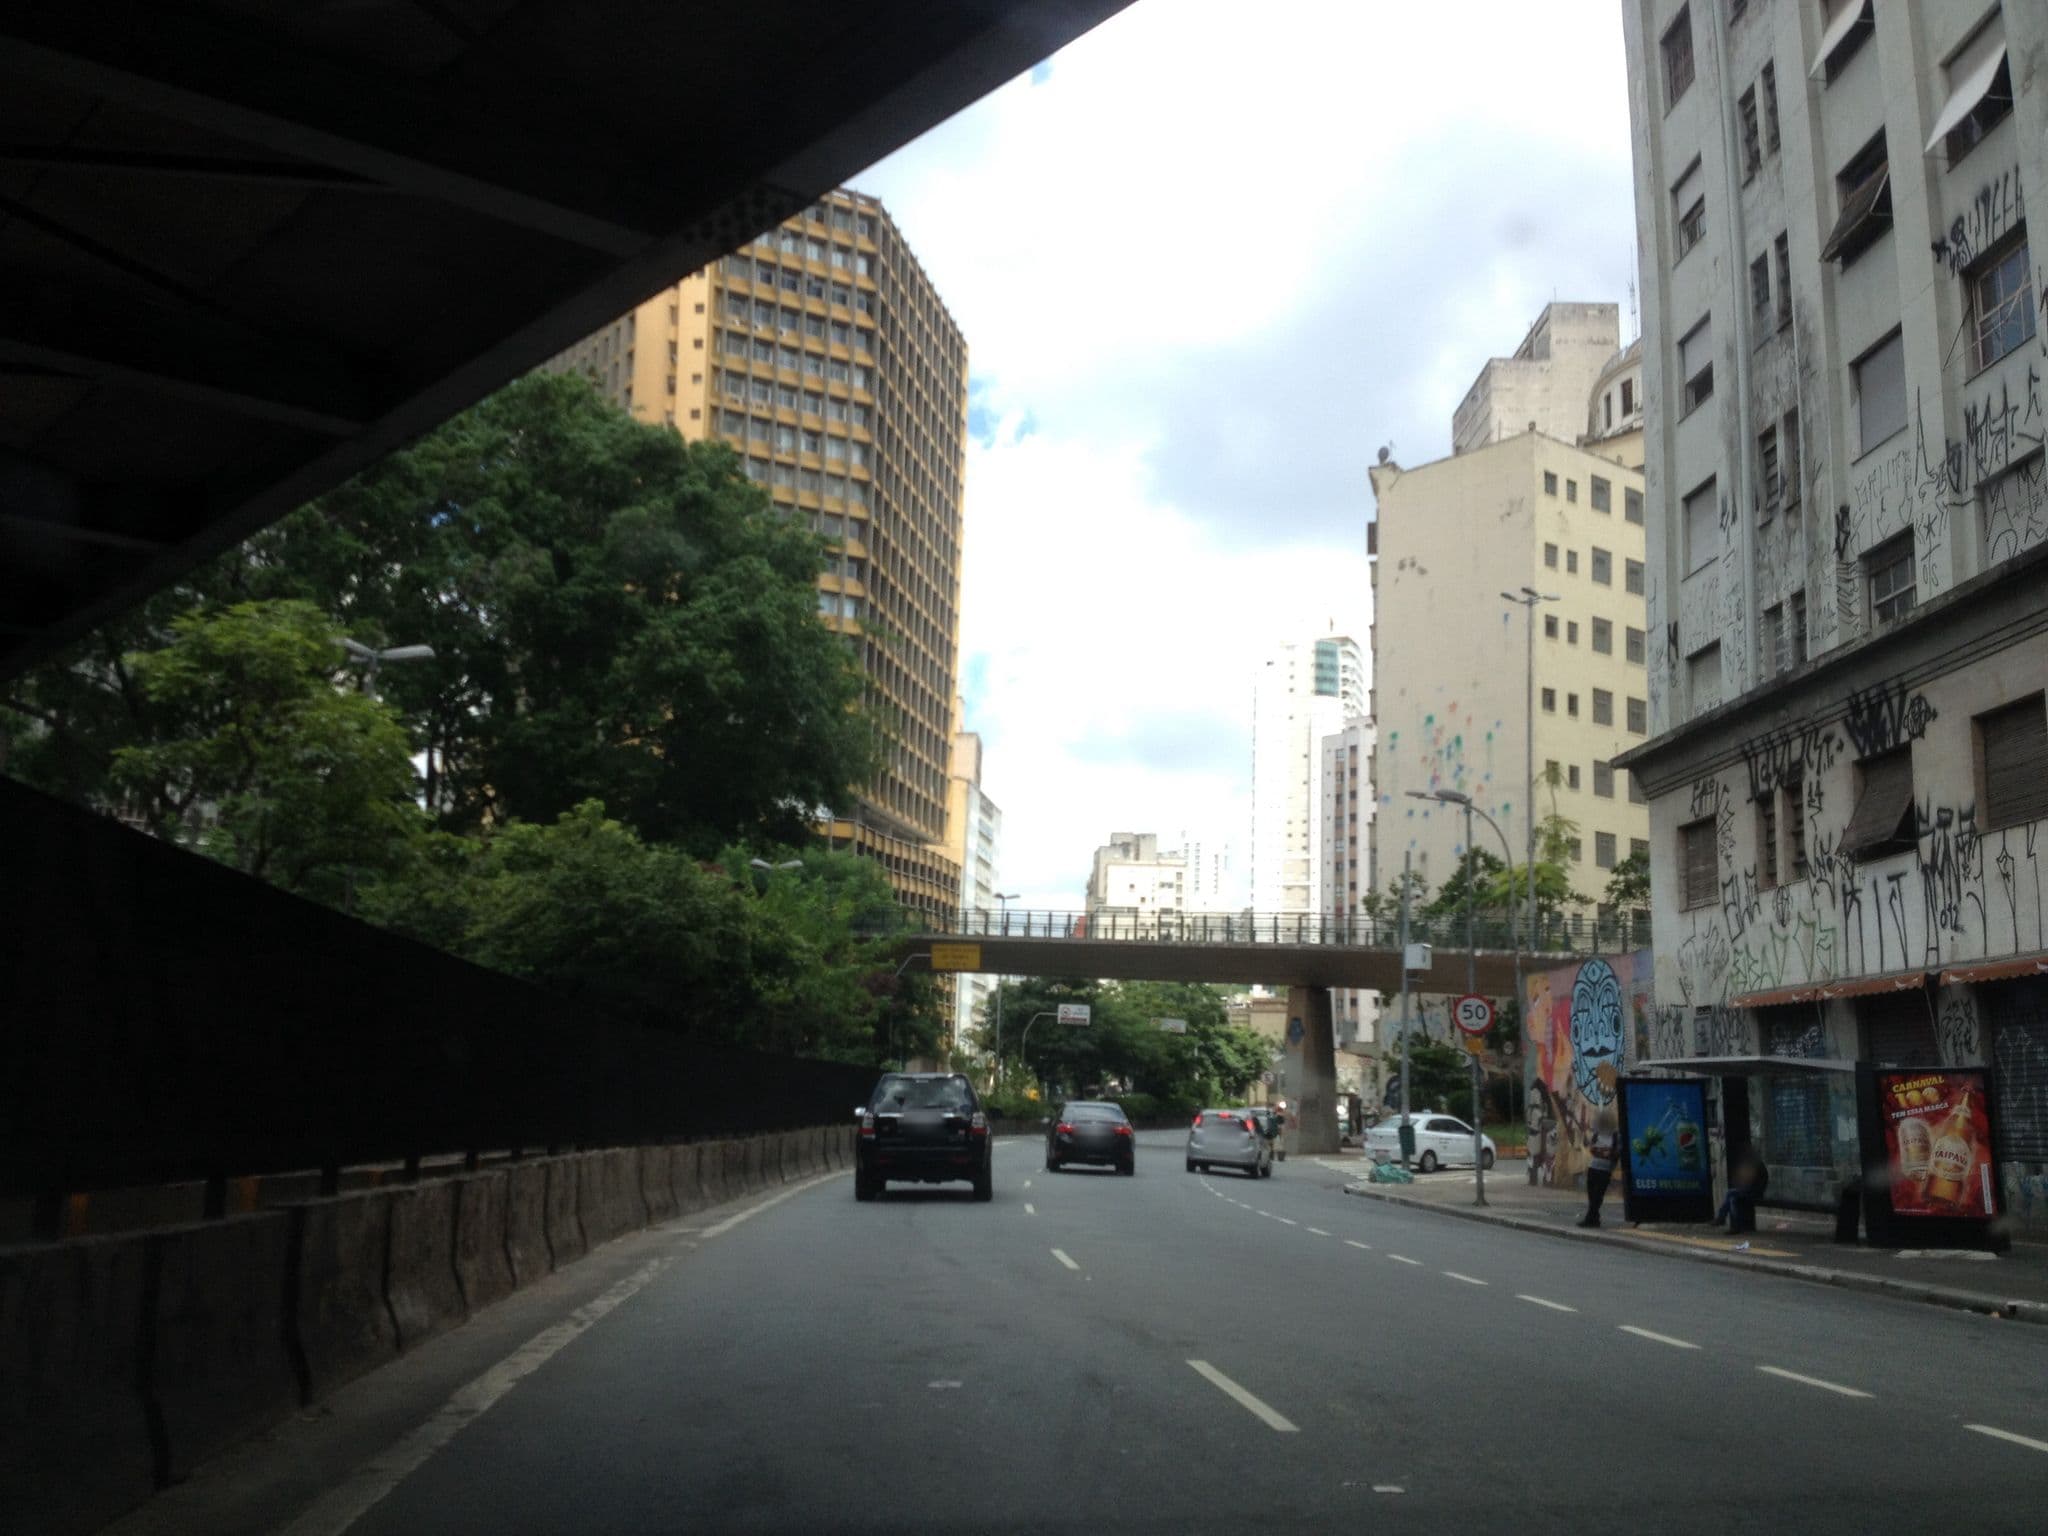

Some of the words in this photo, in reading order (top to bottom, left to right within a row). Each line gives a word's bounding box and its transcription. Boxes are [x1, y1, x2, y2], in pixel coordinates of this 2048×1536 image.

[1463, 1004, 1487, 1020] 50
[1893, 1075, 1945, 1093] CARNAVAL
[1636, 1178, 1657, 1189] ELES
